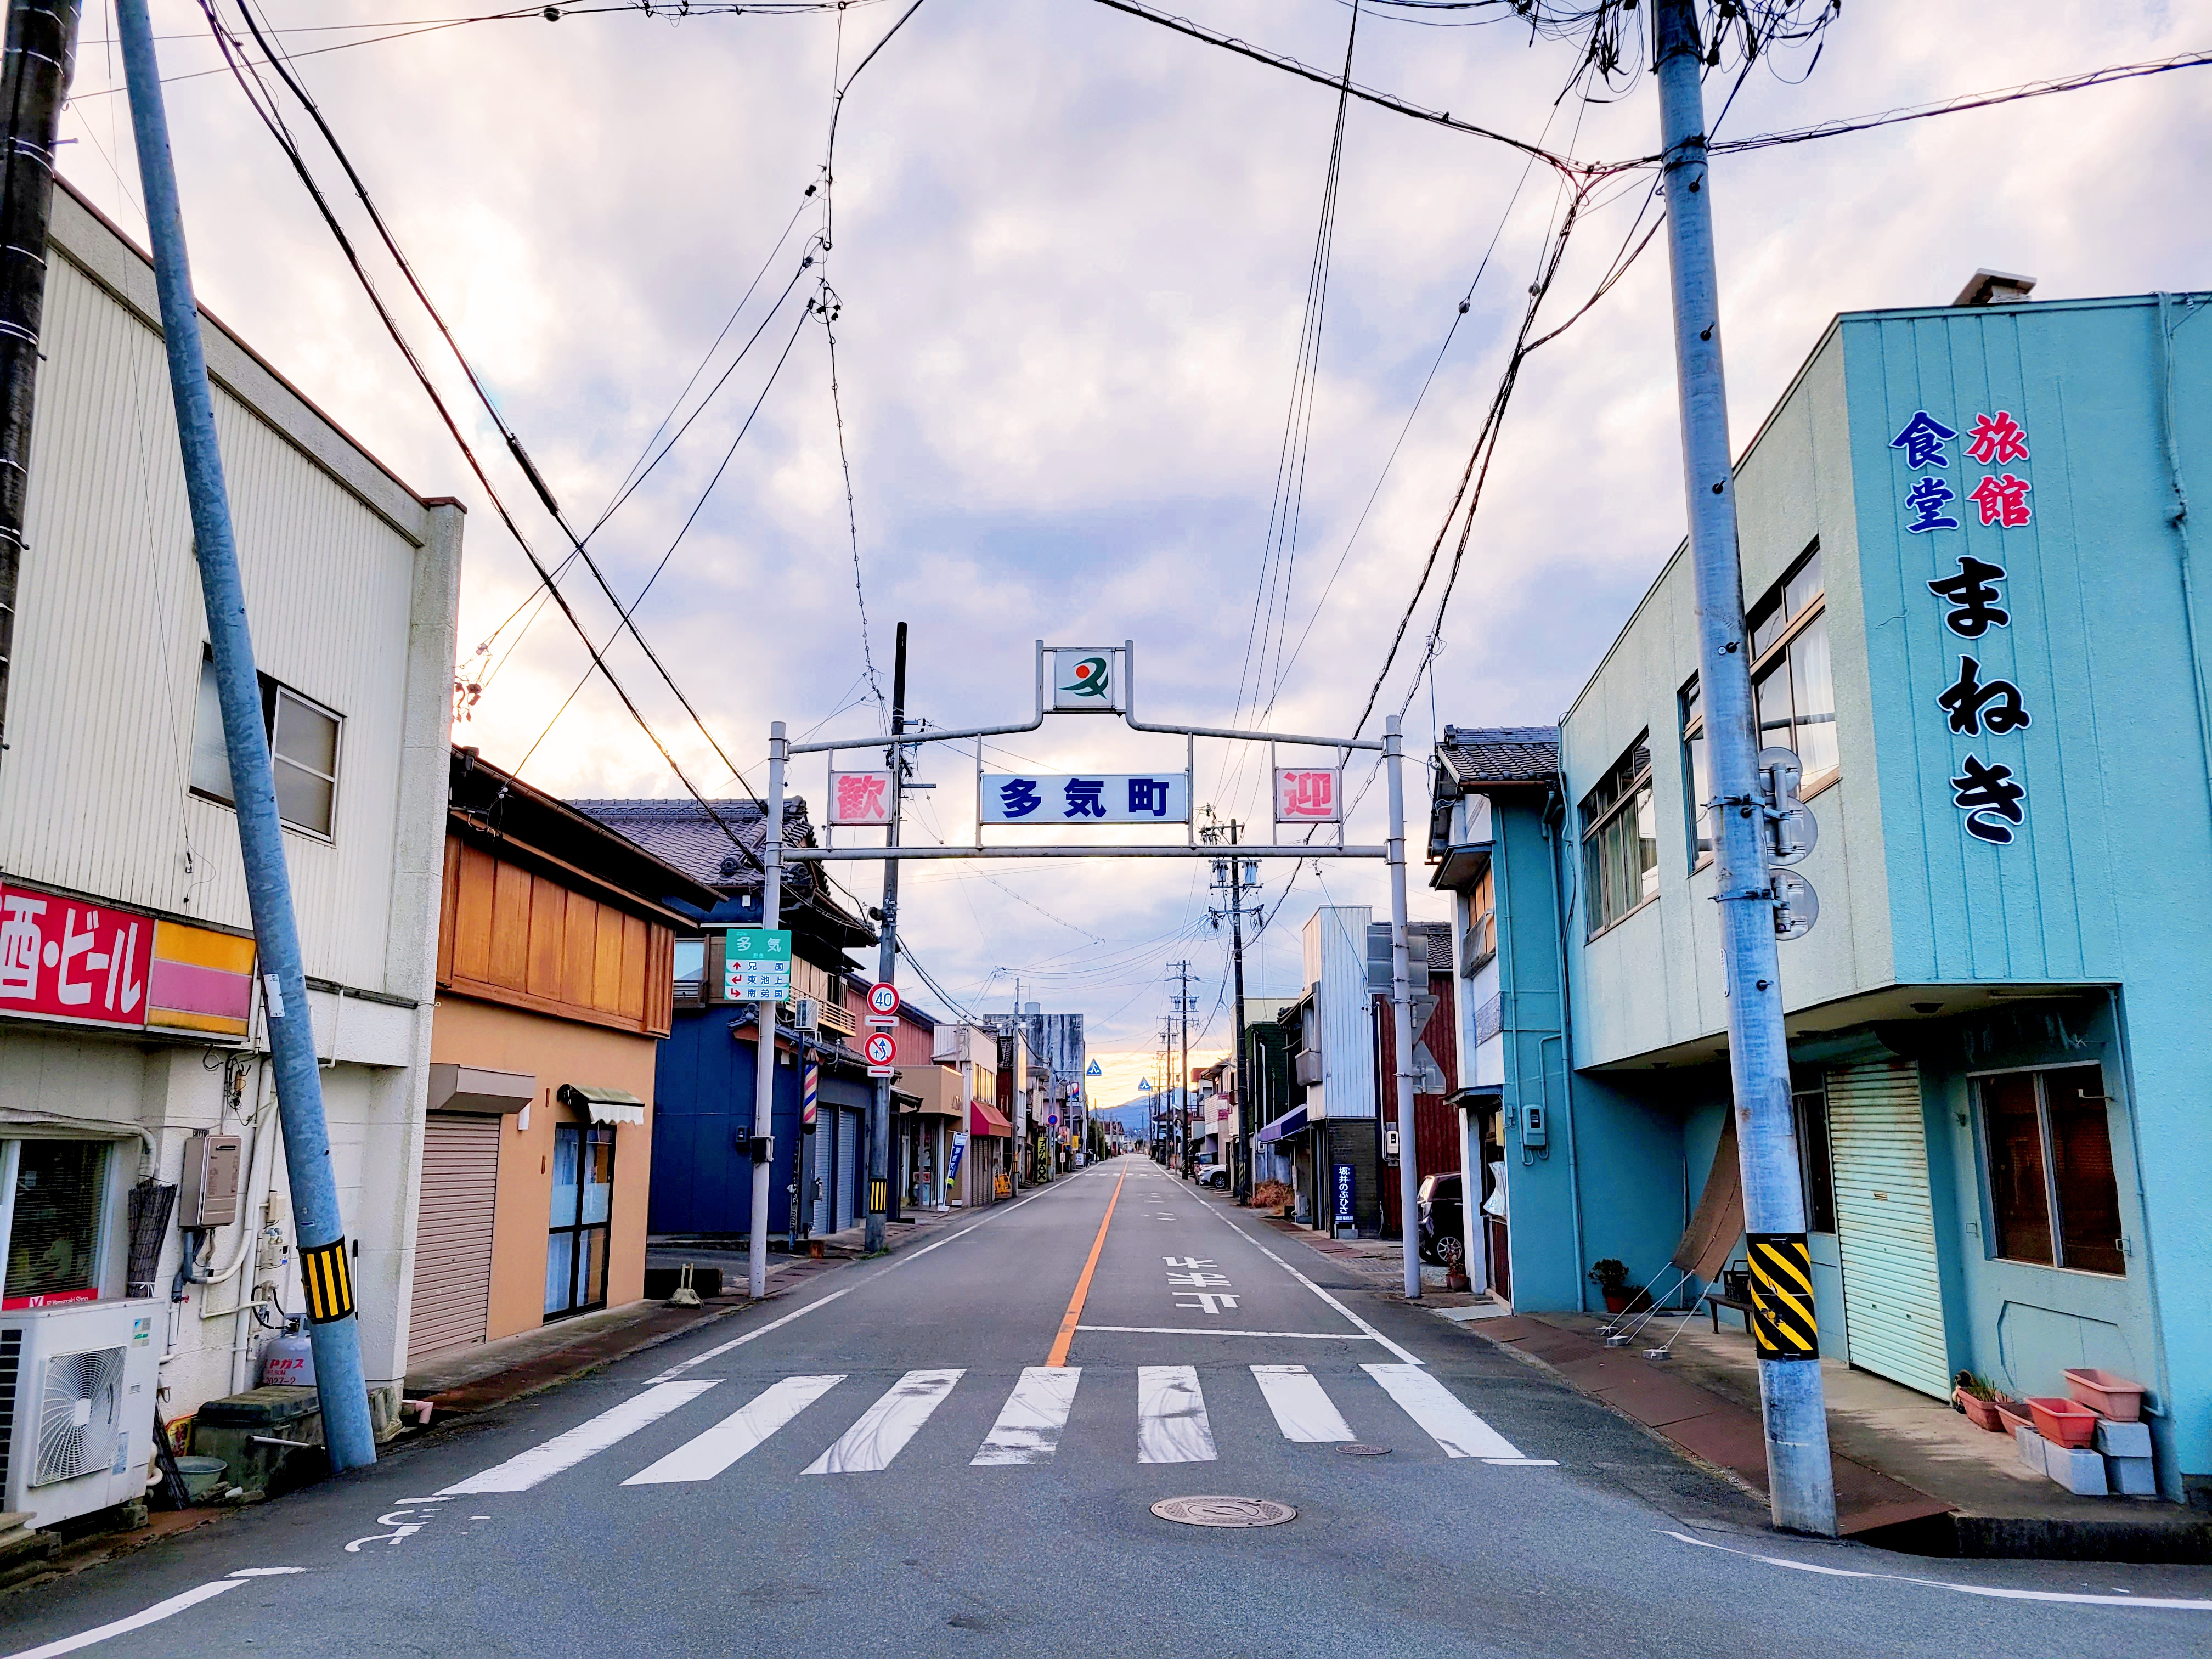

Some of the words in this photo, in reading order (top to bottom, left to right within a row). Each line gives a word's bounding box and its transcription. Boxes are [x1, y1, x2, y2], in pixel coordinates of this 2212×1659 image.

[1889, 410, 1959, 533] 食堂
[1963, 410, 2032, 528] 旅館
[1926, 555, 2032, 844] まねき
[837, 775, 885, 819] 歓
[1000, 778, 1169, 818] 多気町
[1284, 772, 1332, 816] 迎
[737, 936, 782, 952] 多気
[747, 975, 782, 985] 東池上
[748, 962, 783, 971] 兄国
[747, 989, 783, 998] 南弟国
[875, 992, 892, 1006] 40
[1339, 1166, 1349, 1214] 坂井のぶひさ
